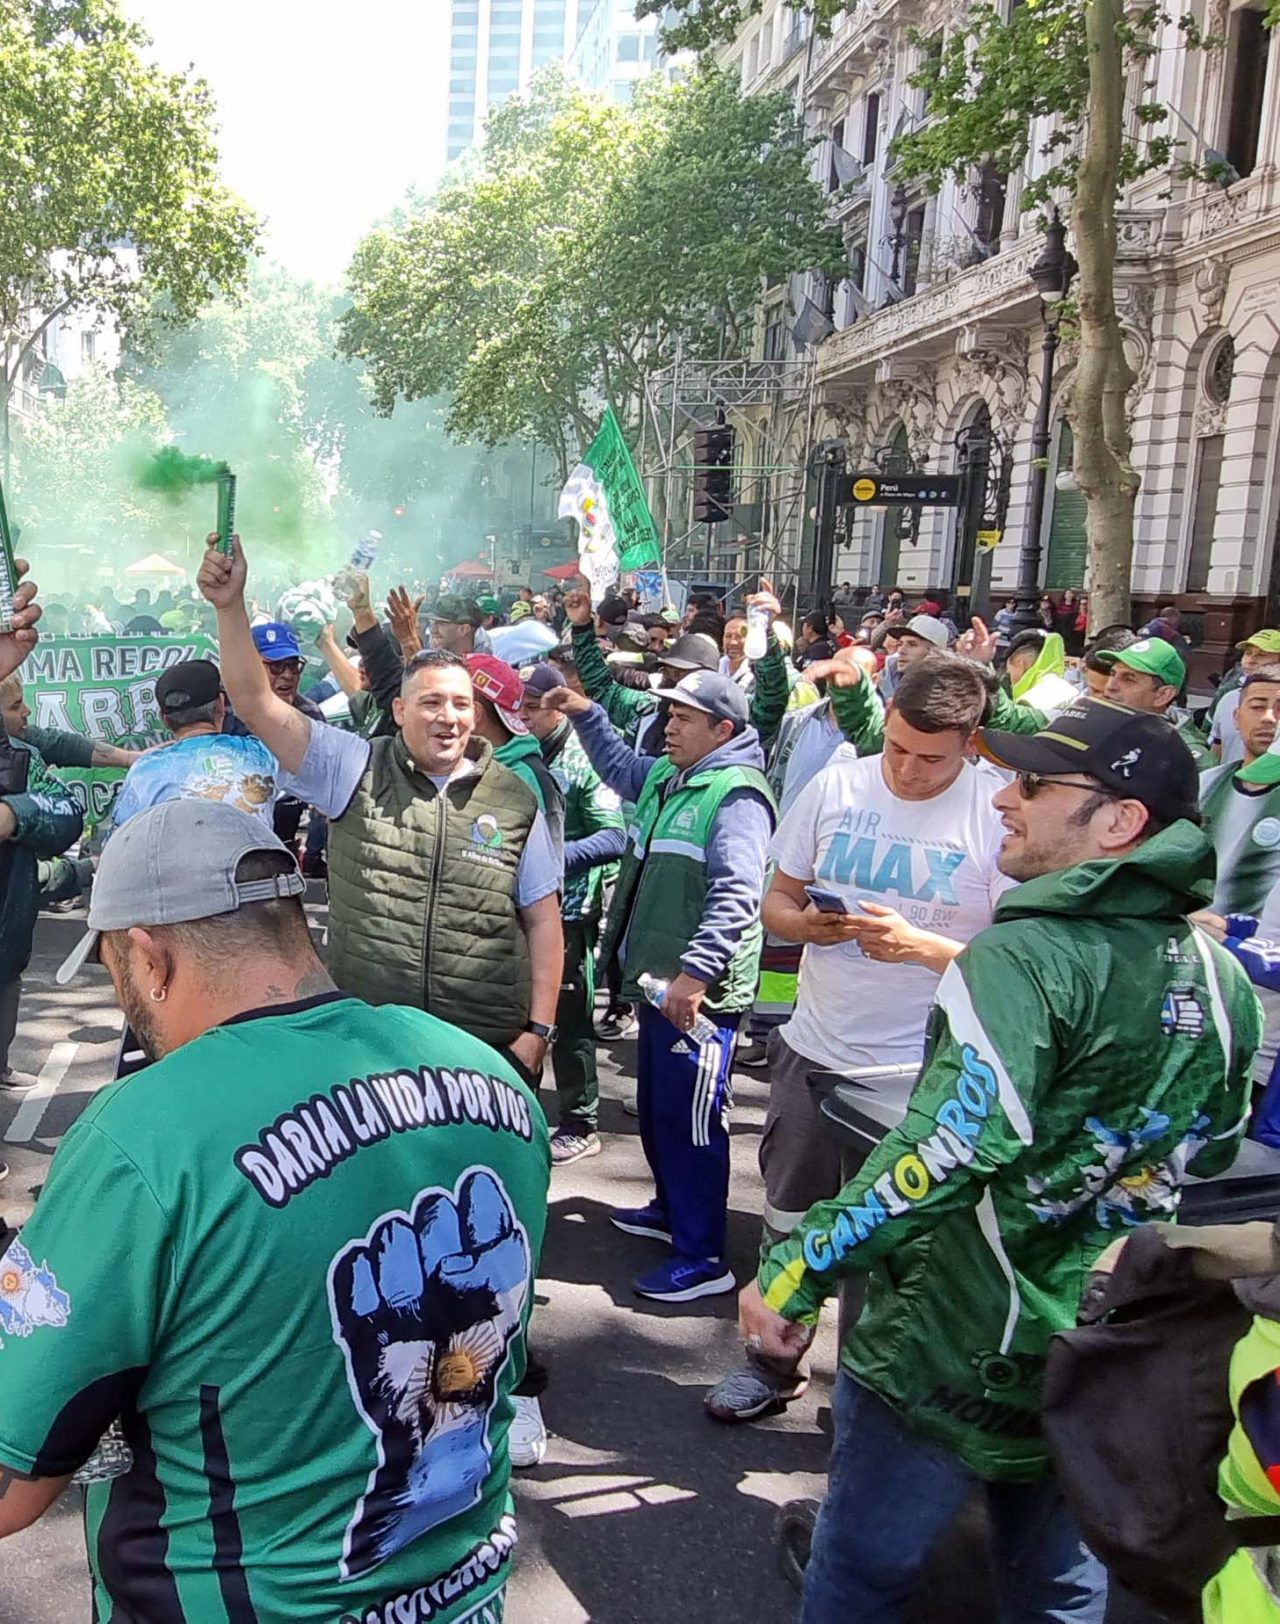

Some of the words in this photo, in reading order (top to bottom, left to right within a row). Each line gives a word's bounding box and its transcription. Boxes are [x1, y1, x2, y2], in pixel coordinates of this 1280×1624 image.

[837, 806, 882, 836] AIR
[817, 830, 968, 907] MAX
[909, 904, 928, 921] 90
[932, 908, 959, 923] BW
[238, 1098, 353, 1204] DARIA
[336, 1079, 387, 1142] LA
[371, 1069, 446, 1128] VIDA
[440, 1069, 497, 1128] POR
[492, 1078, 532, 1139] VOS
